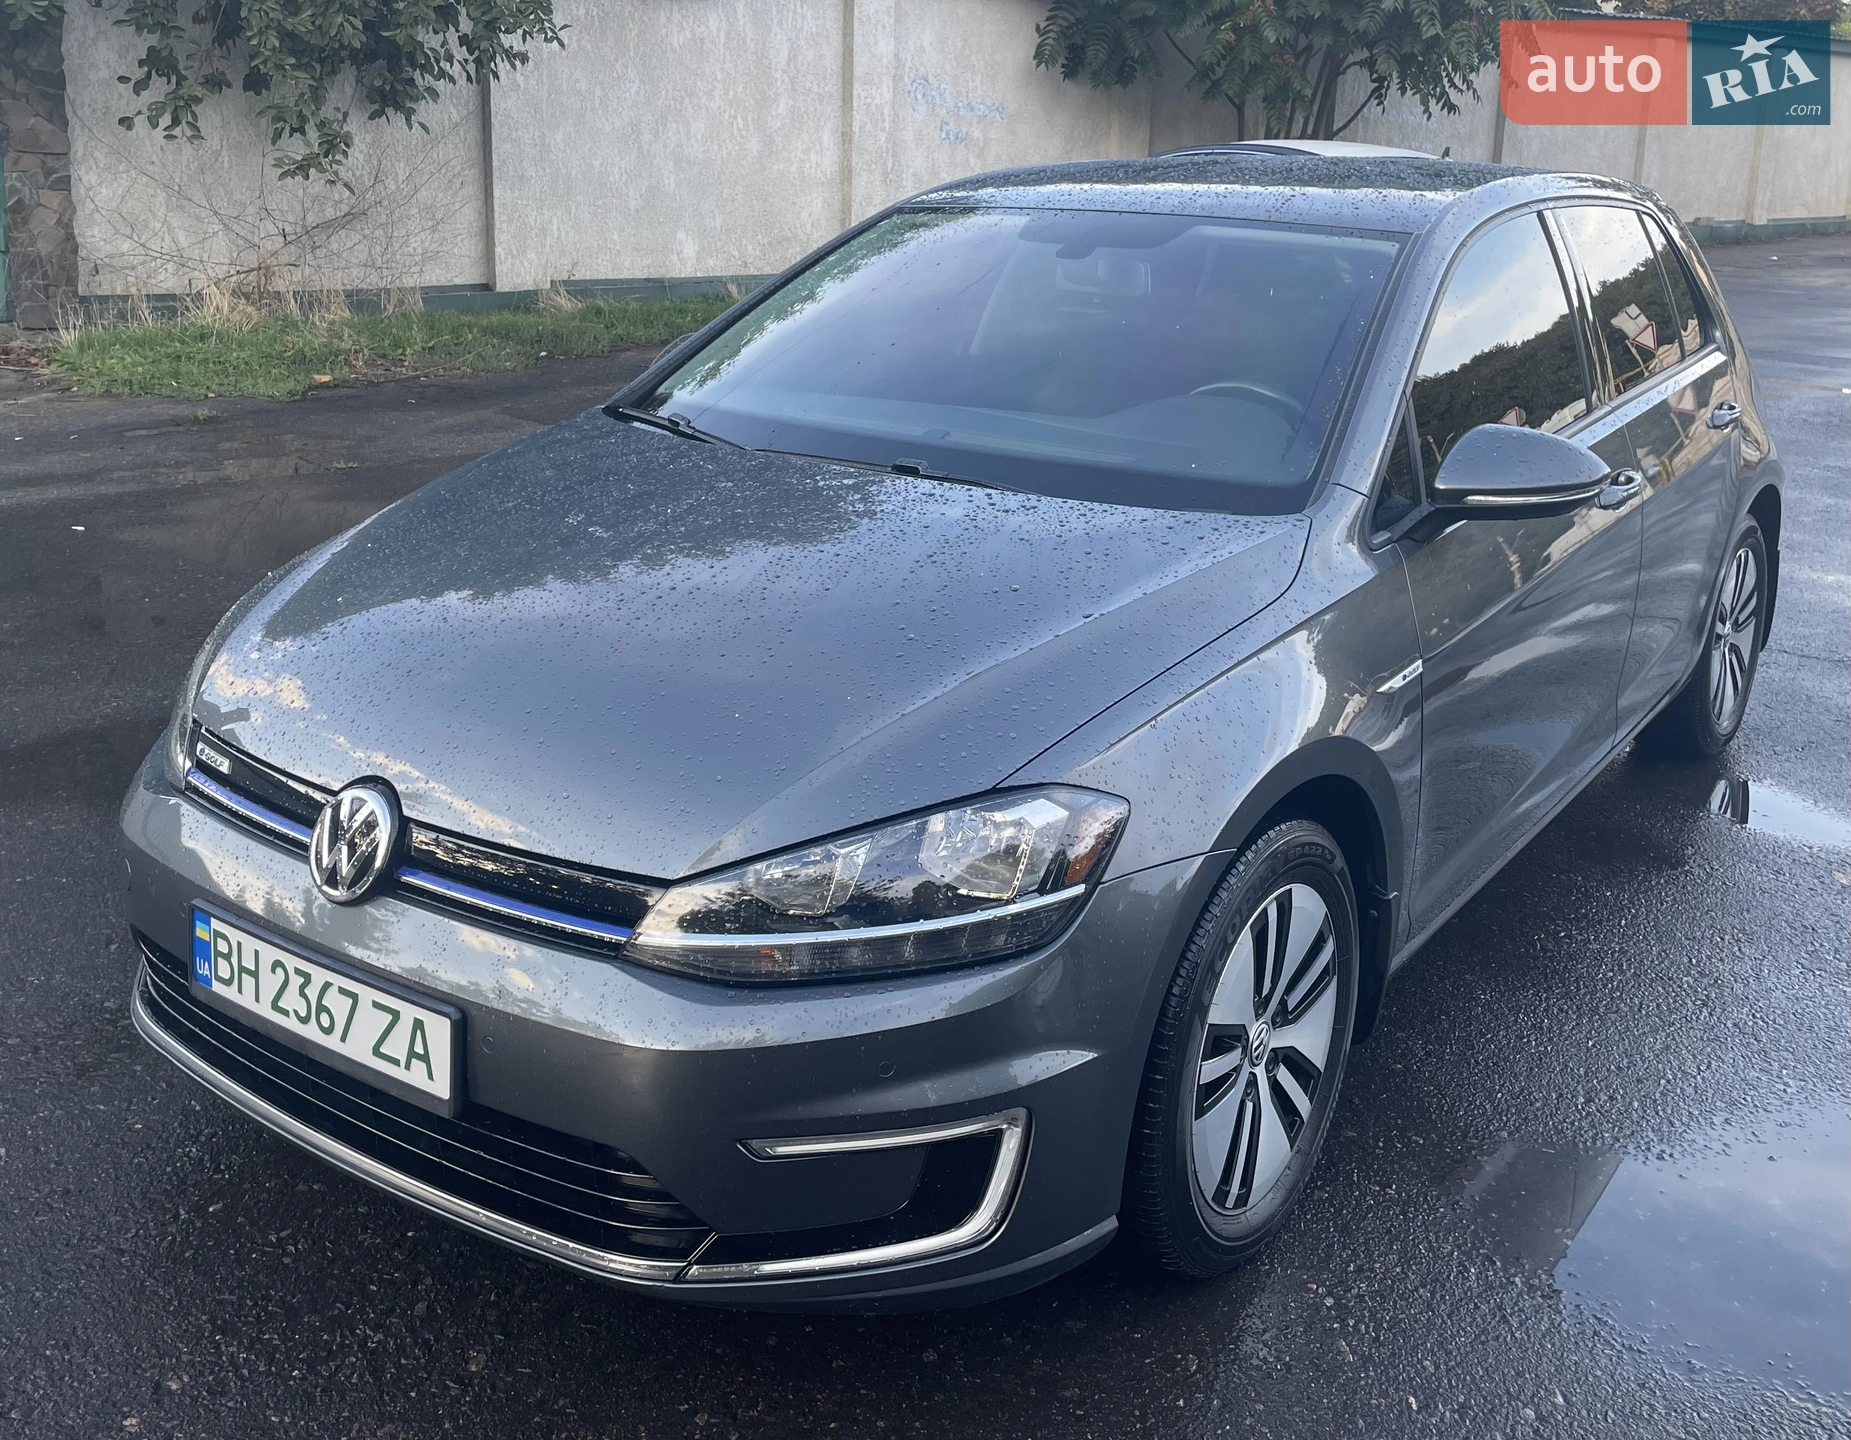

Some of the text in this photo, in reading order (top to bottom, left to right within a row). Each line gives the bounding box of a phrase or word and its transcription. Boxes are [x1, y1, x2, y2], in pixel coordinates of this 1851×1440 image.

[196, 956, 211, 979] UA
[213, 928, 435, 1082] BH 2367 ZA
